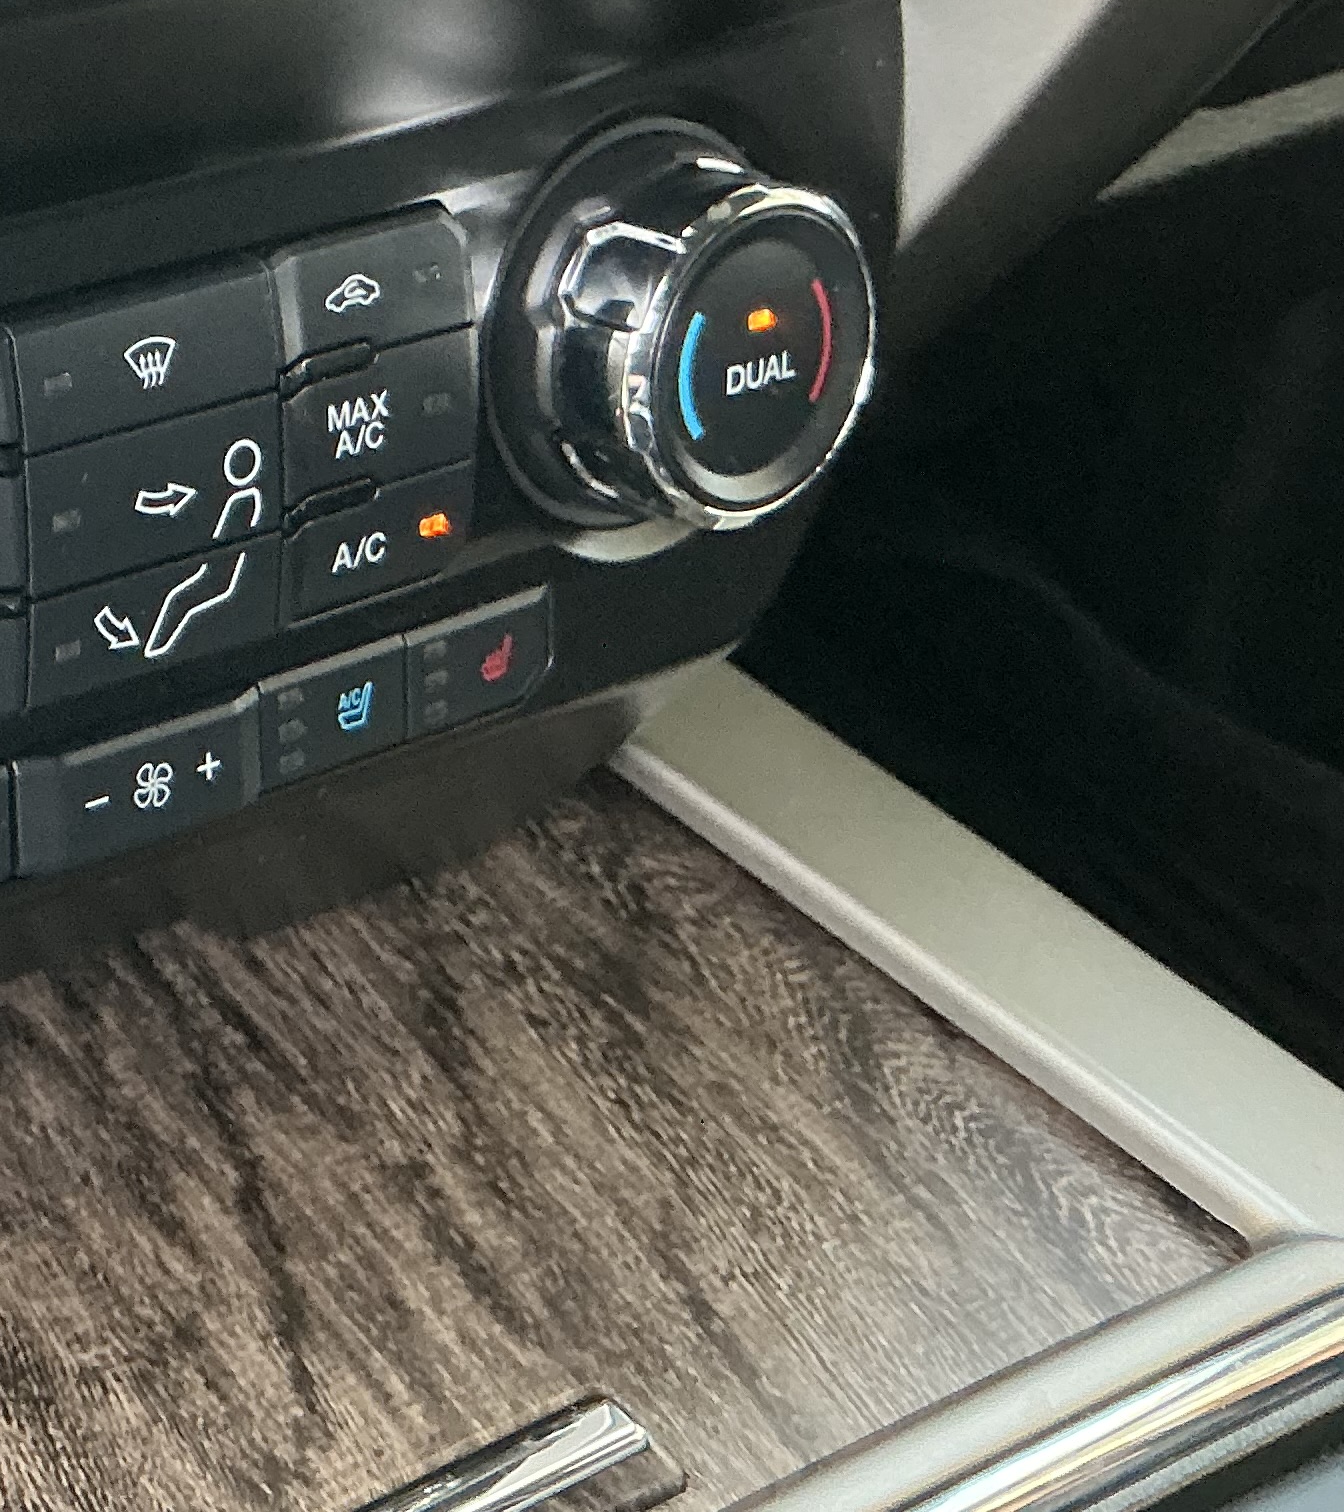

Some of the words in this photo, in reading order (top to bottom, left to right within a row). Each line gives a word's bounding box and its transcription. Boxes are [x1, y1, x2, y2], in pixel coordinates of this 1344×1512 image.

[725, 351, 797, 396] DUAL
[326, 390, 390, 432] MAX
[334, 418, 386, 461] A/C
[331, 530, 388, 574] A/C
